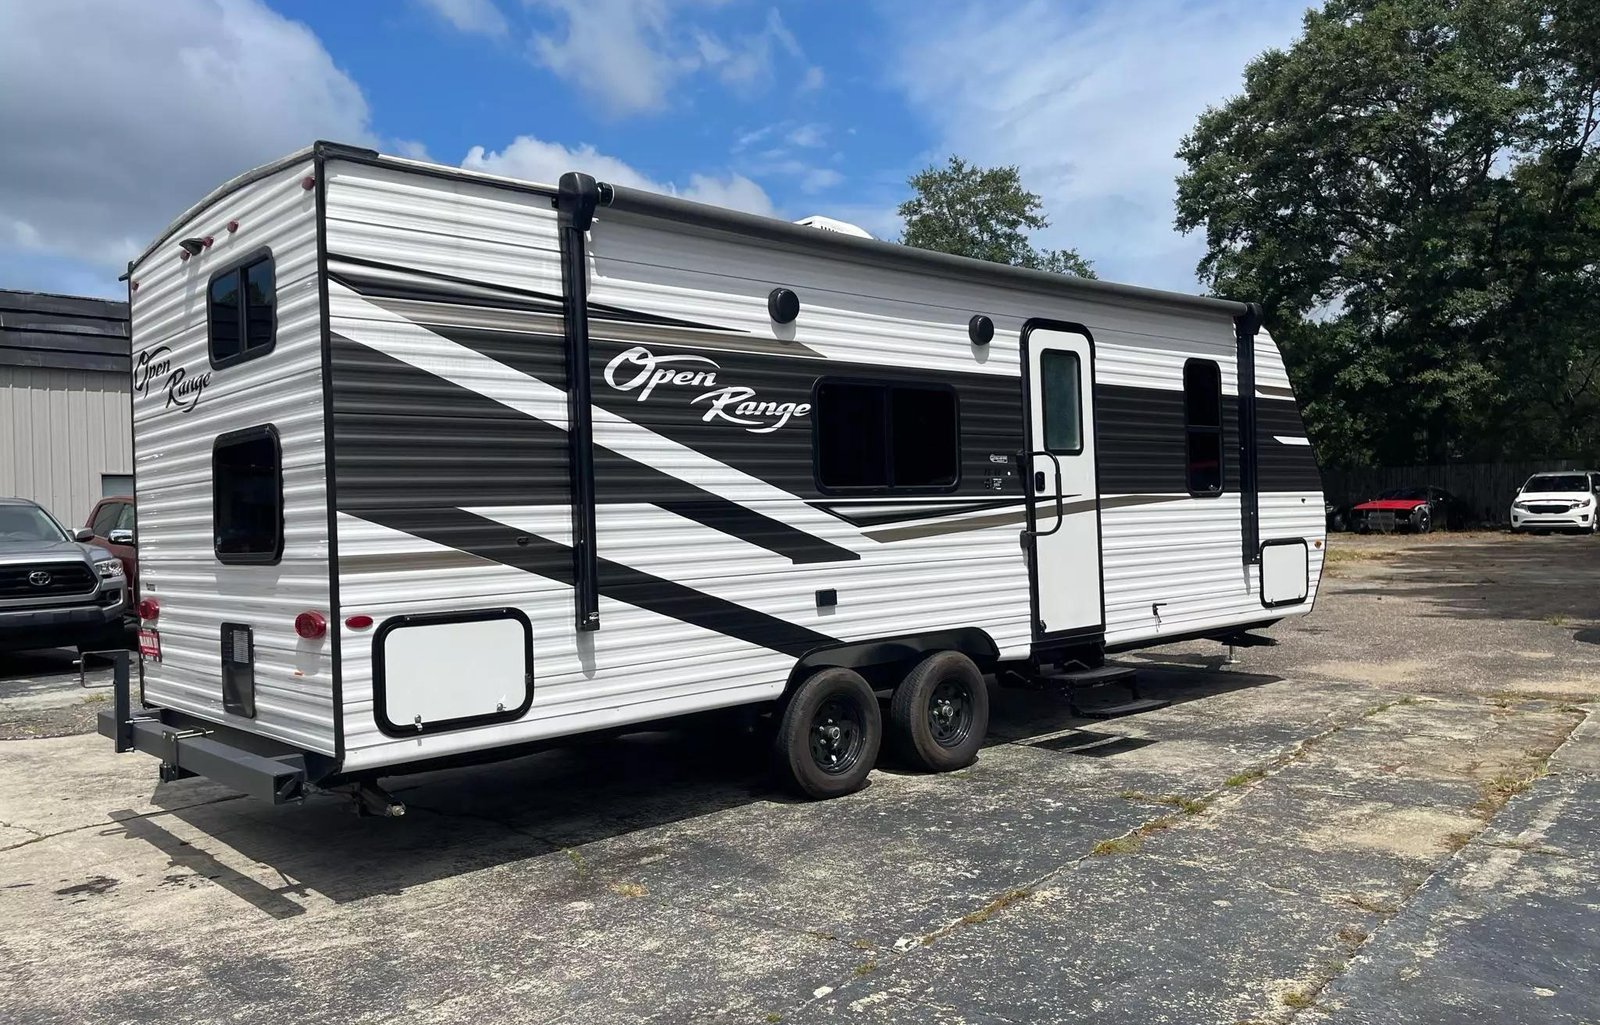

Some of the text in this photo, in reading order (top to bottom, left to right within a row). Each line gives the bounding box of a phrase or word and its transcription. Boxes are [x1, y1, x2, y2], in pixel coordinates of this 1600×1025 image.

[134, 346, 172, 398] Open
[162, 367, 211, 413] Range
[603, 346, 720, 402] Open
[690, 386, 812, 433] Range
